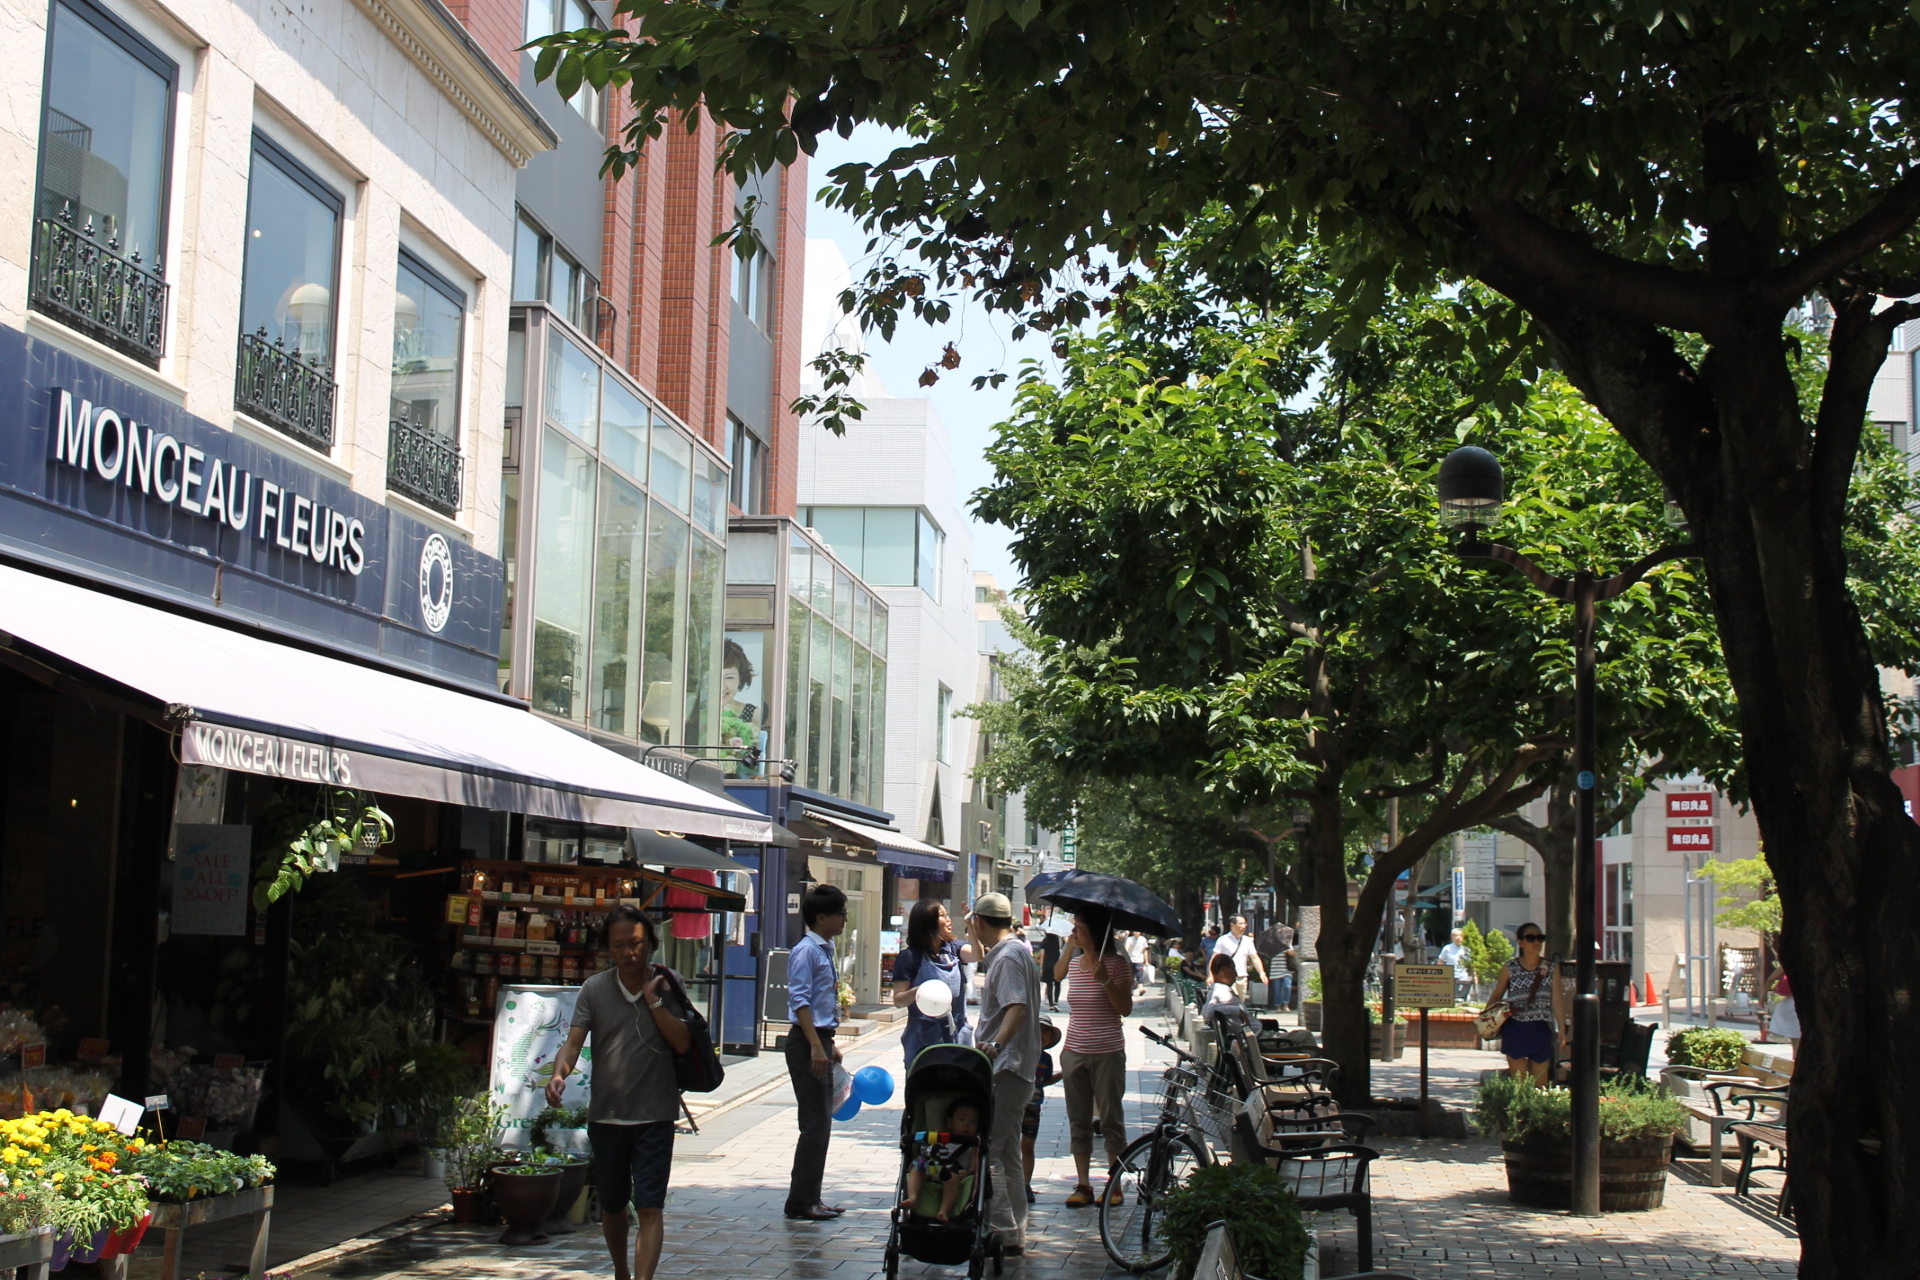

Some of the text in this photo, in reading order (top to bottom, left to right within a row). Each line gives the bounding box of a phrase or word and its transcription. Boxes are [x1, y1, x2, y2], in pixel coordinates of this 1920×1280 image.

[56, 389, 366, 577] MONCEAU FLEURS
[422, 538, 451, 583] MONCEAU
[422, 594, 448, 628] FLEURS
[195, 726, 352, 785] MONCEAU FLEURS
[1671, 799, 1709, 811] 無印良品
[1672, 833, 1711, 845] 無印良品
[193, 853, 231, 868] SALE
[196, 871, 225, 885] ALL
